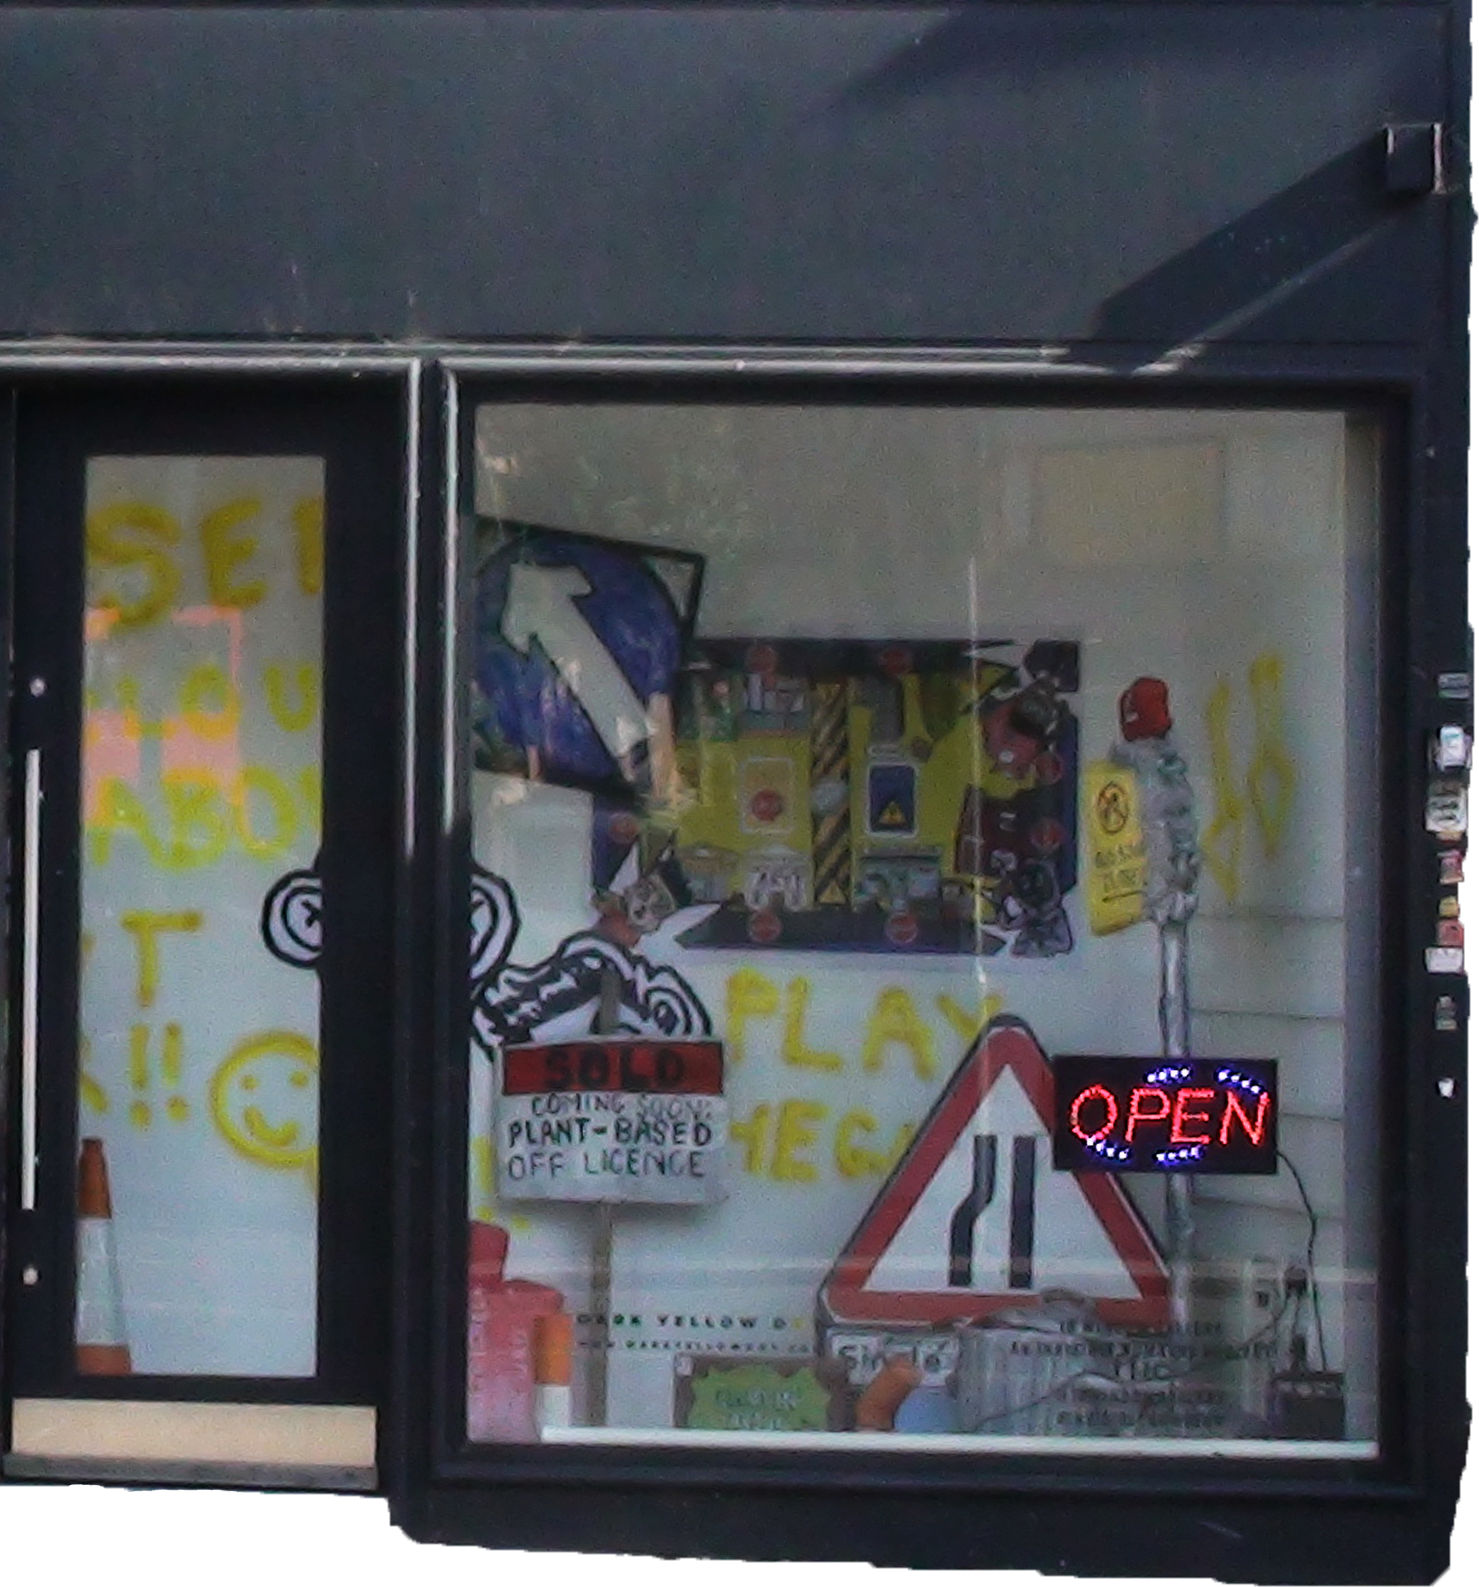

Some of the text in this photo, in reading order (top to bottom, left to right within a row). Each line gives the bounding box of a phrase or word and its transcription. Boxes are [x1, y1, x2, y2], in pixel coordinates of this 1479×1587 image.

[545, 1050, 684, 1088] SOLD
[532, 1093, 626, 1117] COMING
[1071, 1084, 1270, 1145] OPEN
[509, 1116, 712, 1148] PLANT-BASED
[509, 1149, 706, 1181] OFF LICENCE
[657, 1315, 756, 1328] YELLOW
